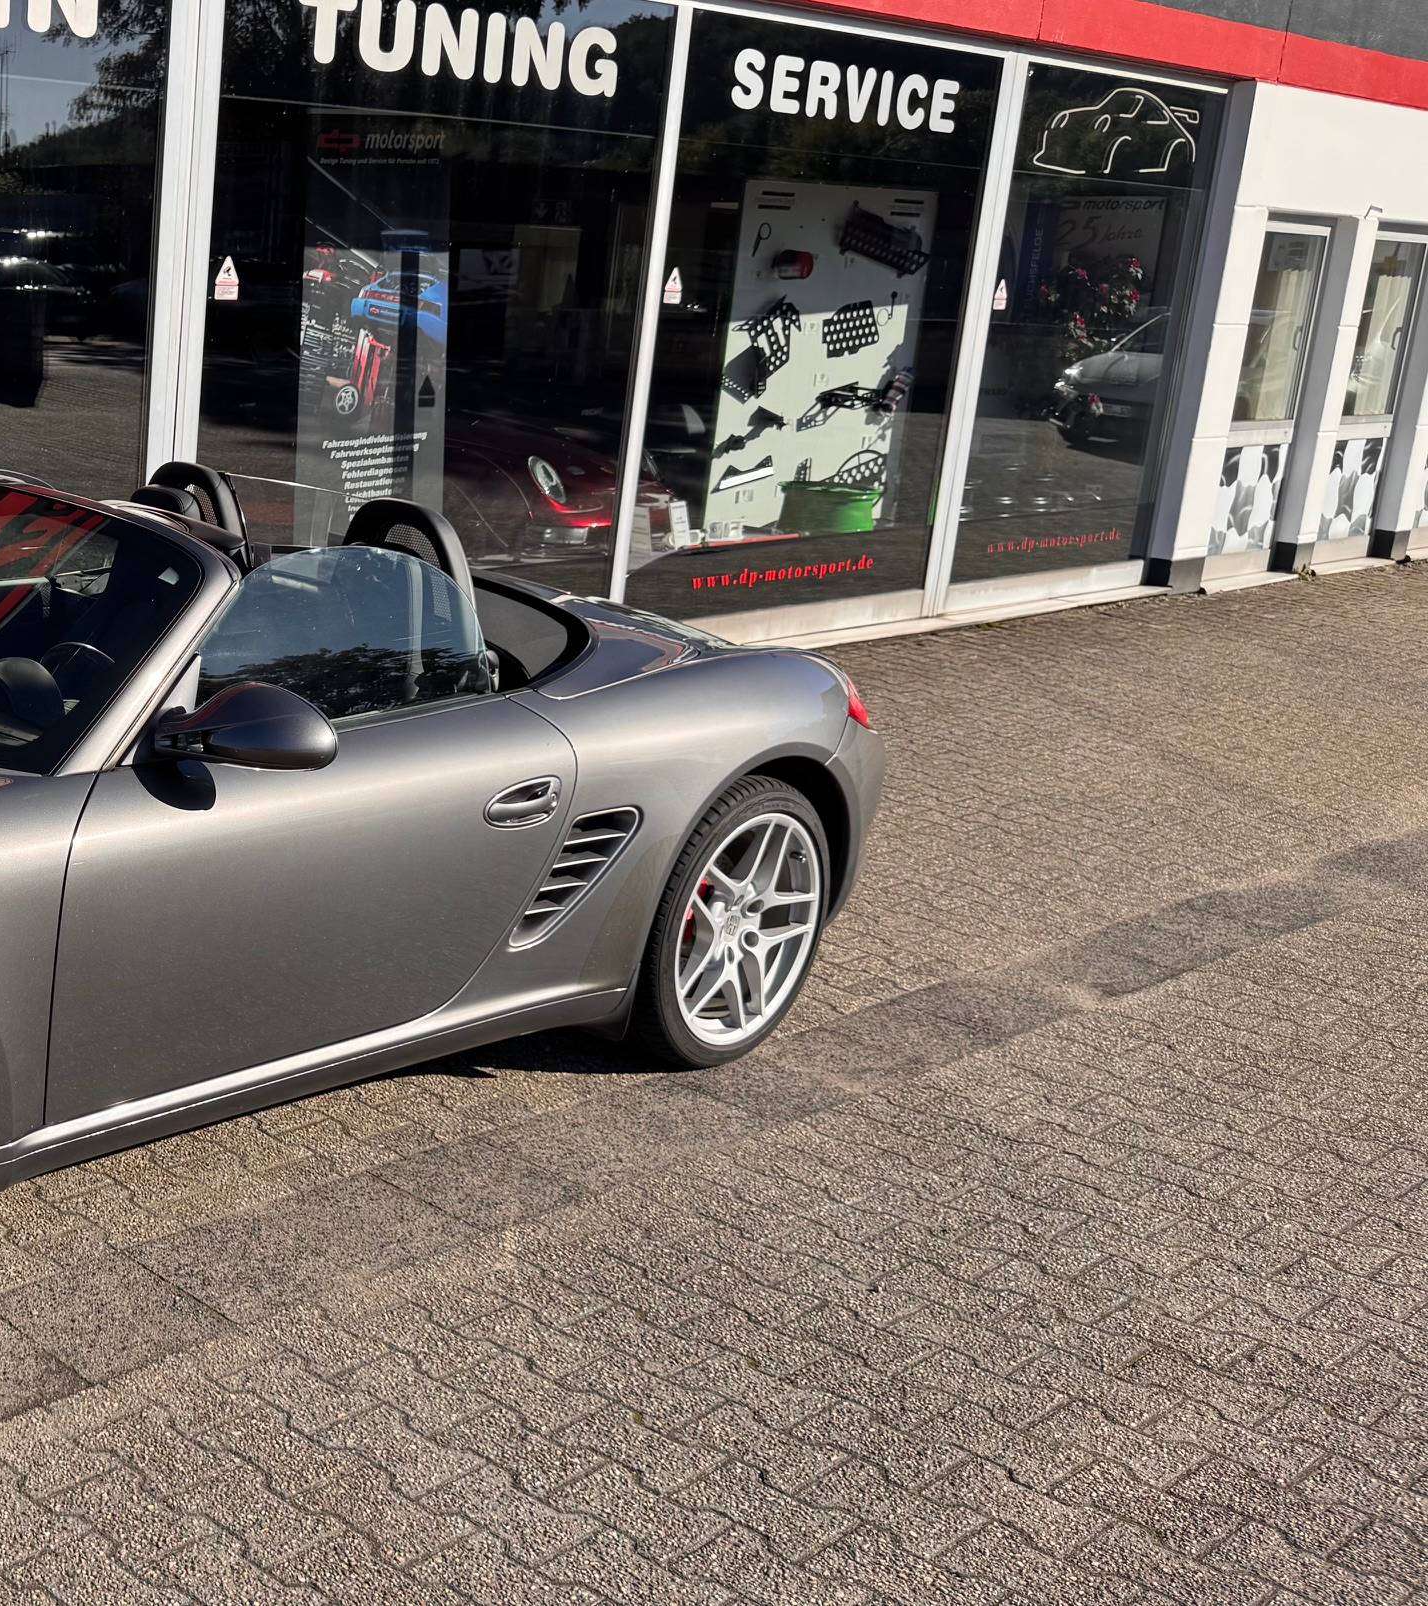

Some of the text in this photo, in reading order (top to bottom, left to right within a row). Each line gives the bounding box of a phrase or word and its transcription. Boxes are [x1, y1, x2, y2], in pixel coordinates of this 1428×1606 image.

[299, 0, 619, 98] TUNING
[731, 48, 960, 134] SERVICE
[364, 128, 446, 154] motorsport
[1082, 197, 1164, 212] motorsport
[321, 432, 428, 450] Fahrzeugindividualisierung
[330, 443, 420, 459] Fahrwerksoptimierung
[340, 455, 410, 470] Spezialumbauten
[341, 466, 409, 480] Fehlerdiagnosen
[987, 527, 1123, 553] www.dp-motorsport.de
[692, 553, 875, 591] www.dp-motorsport.de
